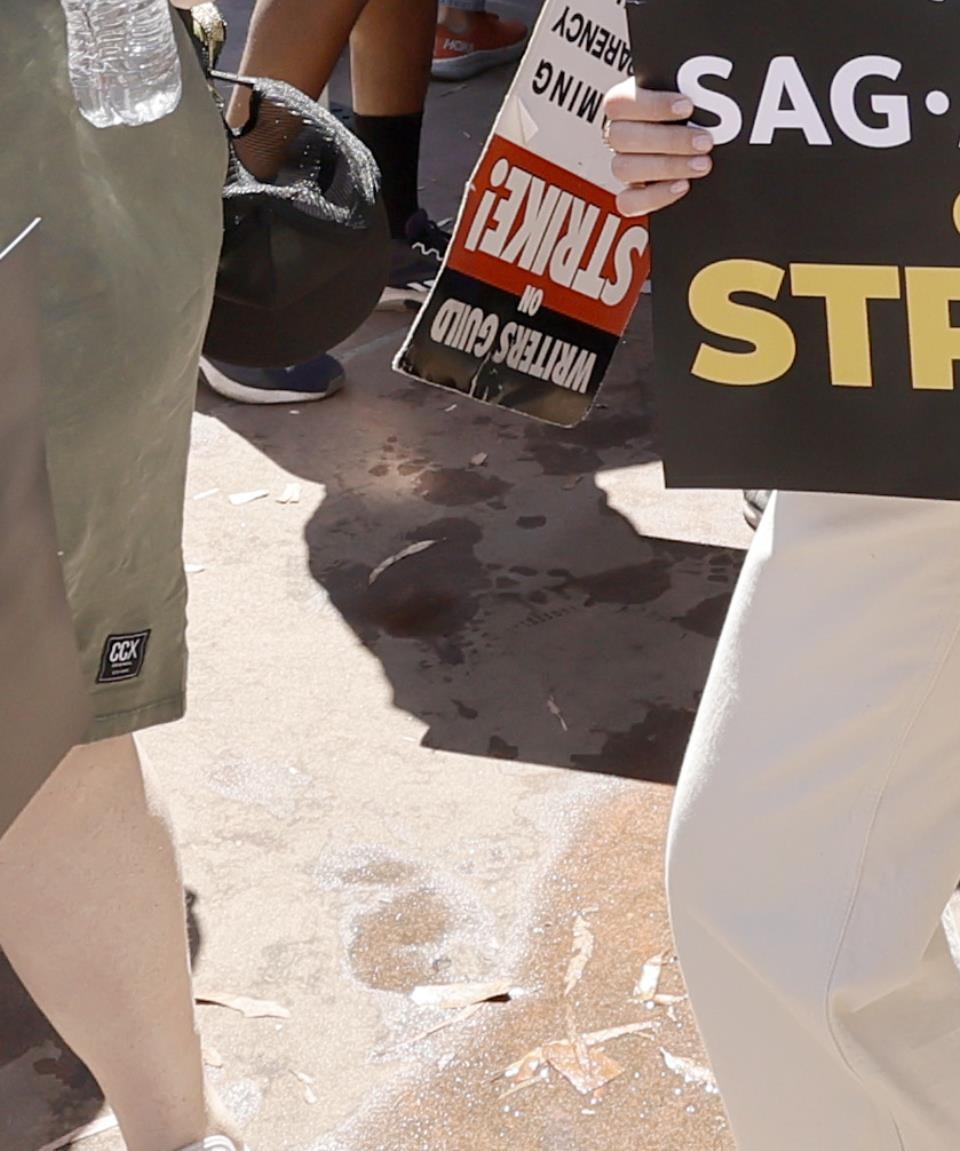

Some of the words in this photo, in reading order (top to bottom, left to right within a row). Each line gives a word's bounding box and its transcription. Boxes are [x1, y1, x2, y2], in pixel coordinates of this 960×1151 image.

[531, 58, 607, 130] MING
[464, 158, 649, 306] STRIKE!
[430, 298, 500, 358] GUILD
[517, 284, 544, 317] ON
[492, 321, 598, 394] WRITERS
[109, 638, 141, 663] CCX
